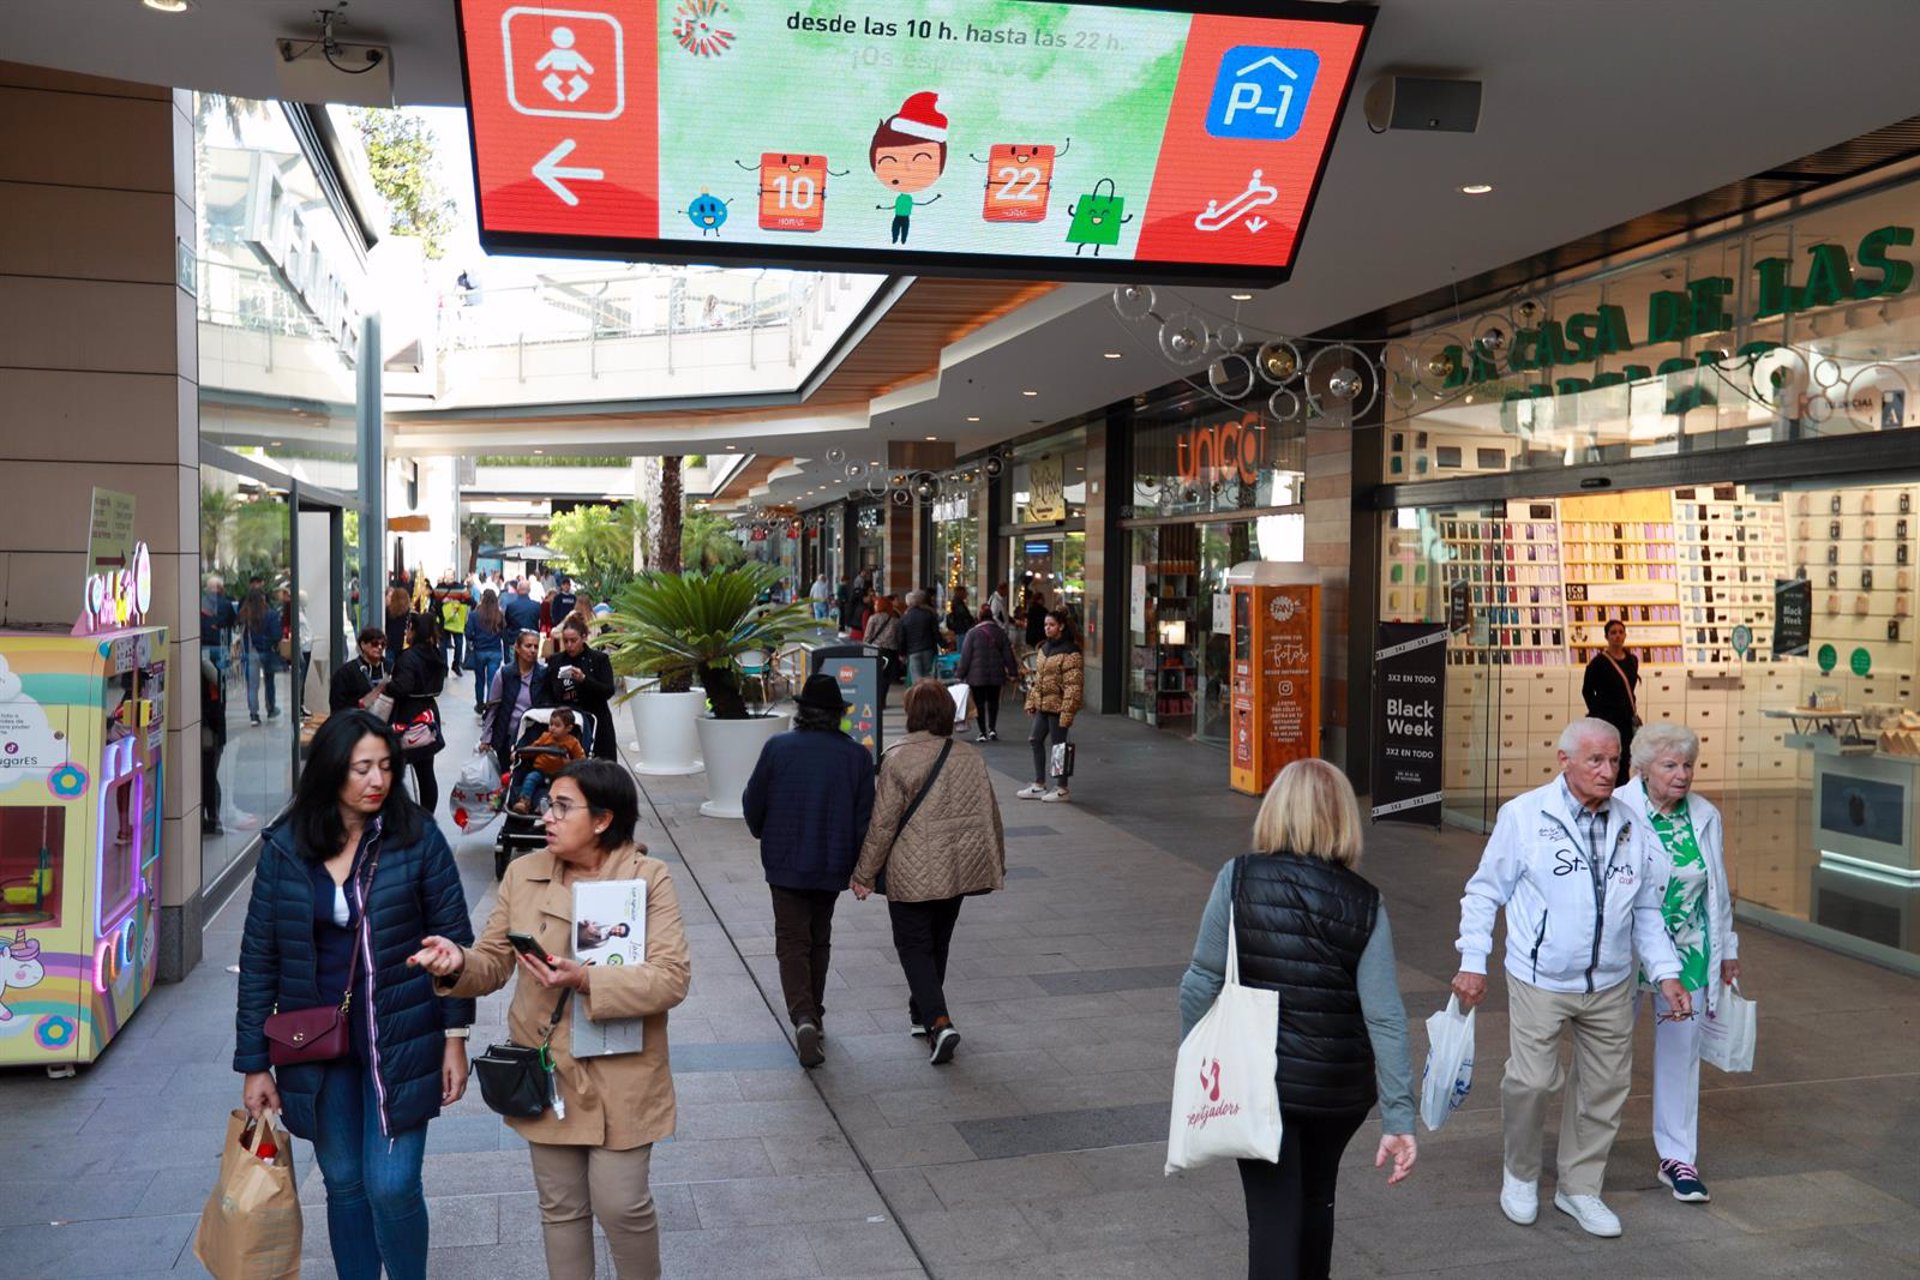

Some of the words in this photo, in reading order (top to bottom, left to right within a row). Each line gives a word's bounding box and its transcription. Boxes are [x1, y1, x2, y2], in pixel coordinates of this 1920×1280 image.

[786, 11, 857, 34] desde
[863, 17, 898, 37] las
[906, 19, 932, 39] 10
[938, 21, 958, 41] h.
[966, 24, 1027, 45] hasta
[1034, 28, 1067, 48] las
[1073, 31, 1100, 49] 22
[1223, 82, 1293, 128] P-1
[771, 174, 815, 209] 10
[994, 166, 1042, 201] 22
[1509, 305, 1633, 372] CASA
[1648, 276, 1735, 346] DE
[1753, 225, 1915, 321] LAS
[1273, 604, 1292, 613] FAN
[1264, 643, 1309, 667] fotos
[1388, 674, 1401, 682] 3X2
[1403, 674, 1413, 683] EN
[1414, 675, 1436, 684] TODO
[1387, 698, 1434, 719] Black
[1387, 719, 1434, 738] Week
[1386, 748, 1399, 756] 3X2
[1401, 749, 1411, 757] EN
[1412, 750, 1434, 759] TODO
